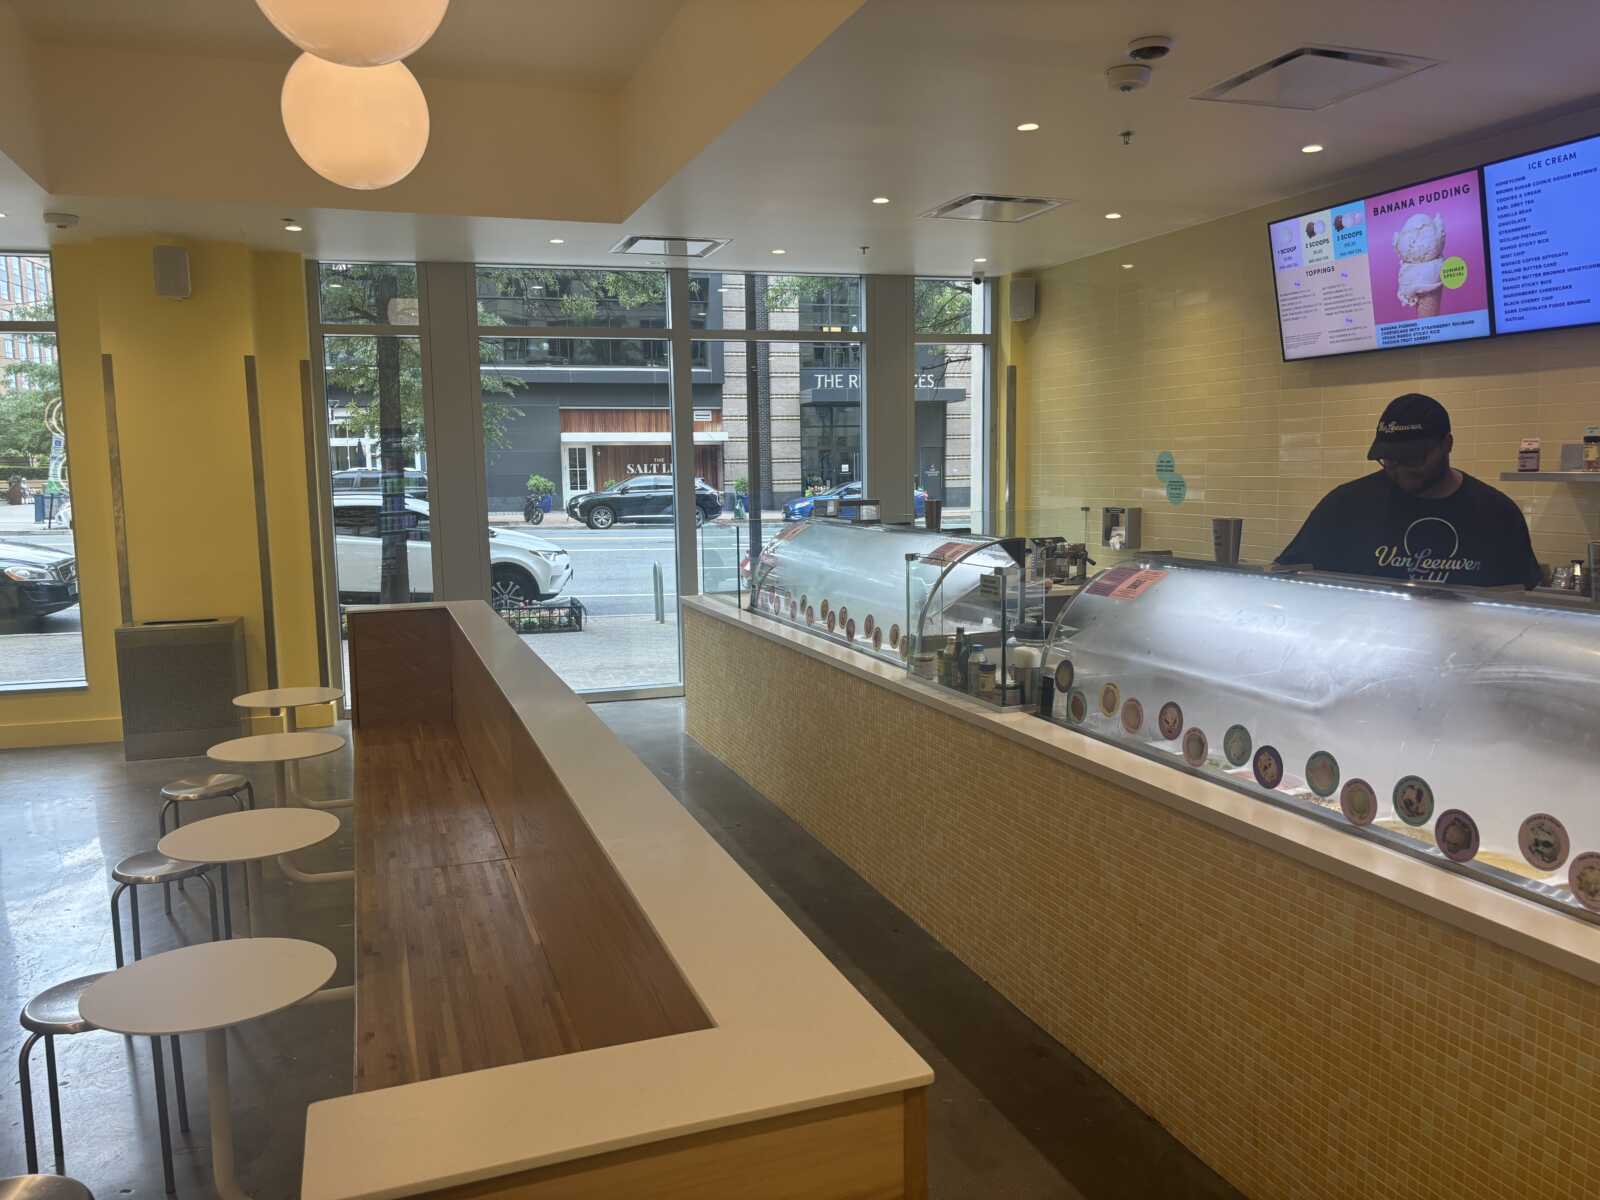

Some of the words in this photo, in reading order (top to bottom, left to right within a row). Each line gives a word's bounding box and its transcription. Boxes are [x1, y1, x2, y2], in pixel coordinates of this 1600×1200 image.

[1528, 160, 1542, 169] ICE
[1545, 152, 1577, 166] CREAM
[1373, 198, 1415, 216] BANANA
[1419, 184, 1470, 205] PUDDING
[1305, 266, 1335, 277] TOPPINGS
[814, 374, 844, 389] THE
[626, 463, 658, 474] SALT
[1375, 545, 1413, 568] Van
